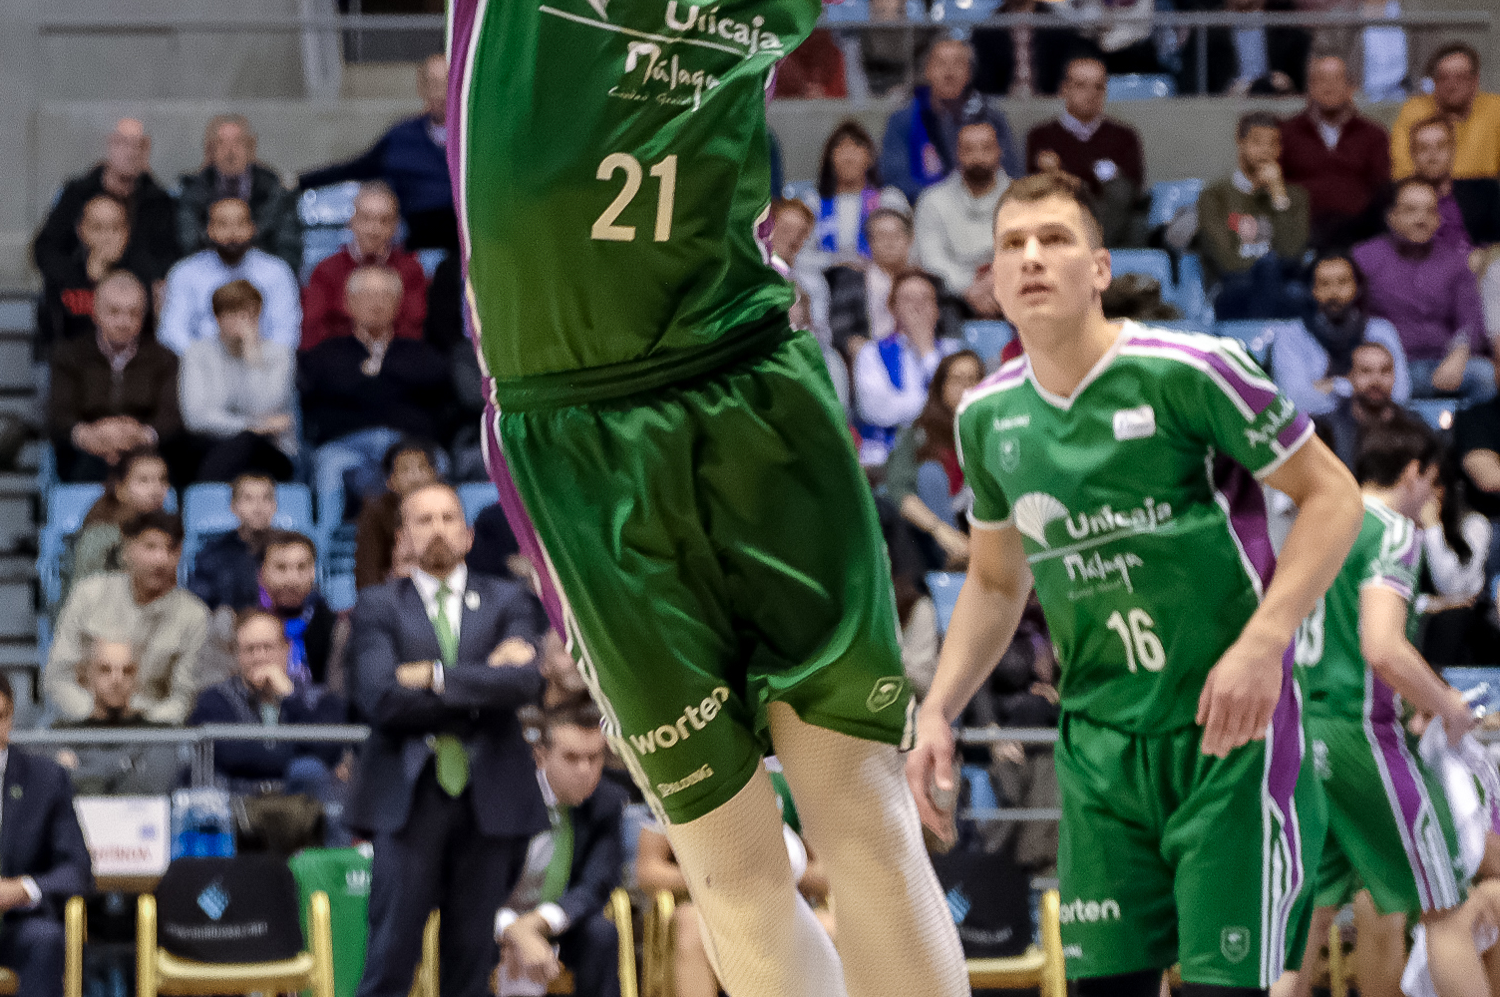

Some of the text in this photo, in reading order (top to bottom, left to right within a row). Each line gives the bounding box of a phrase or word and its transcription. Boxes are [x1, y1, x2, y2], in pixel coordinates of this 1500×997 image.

[590, 152, 678, 242] 21
[1105, 606, 1166, 675] 16
[629, 686, 730, 756] worten
[1059, 898, 1121, 924] orten
